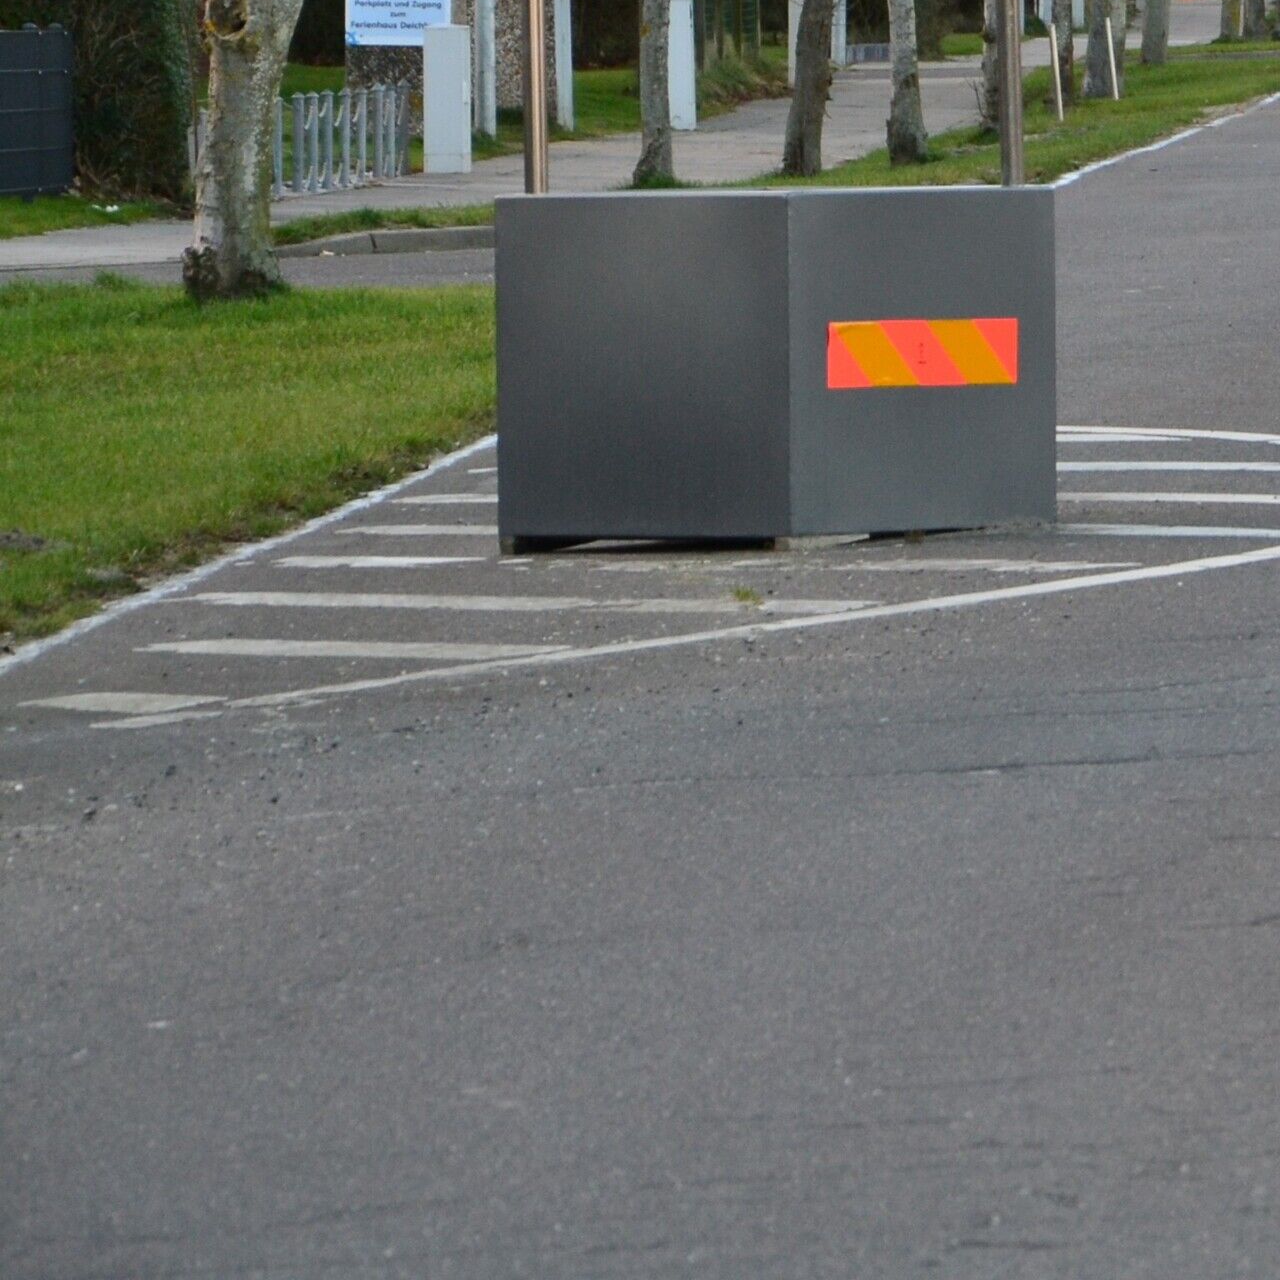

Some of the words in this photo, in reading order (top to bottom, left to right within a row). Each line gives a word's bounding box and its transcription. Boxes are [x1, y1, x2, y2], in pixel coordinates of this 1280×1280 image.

[354, 0, 391, 9] Parkplatz
[394, 0, 409, 8] und
[411, 0, 442, 10] Zugang
[351, 21, 397, 29] Ferienhaus
